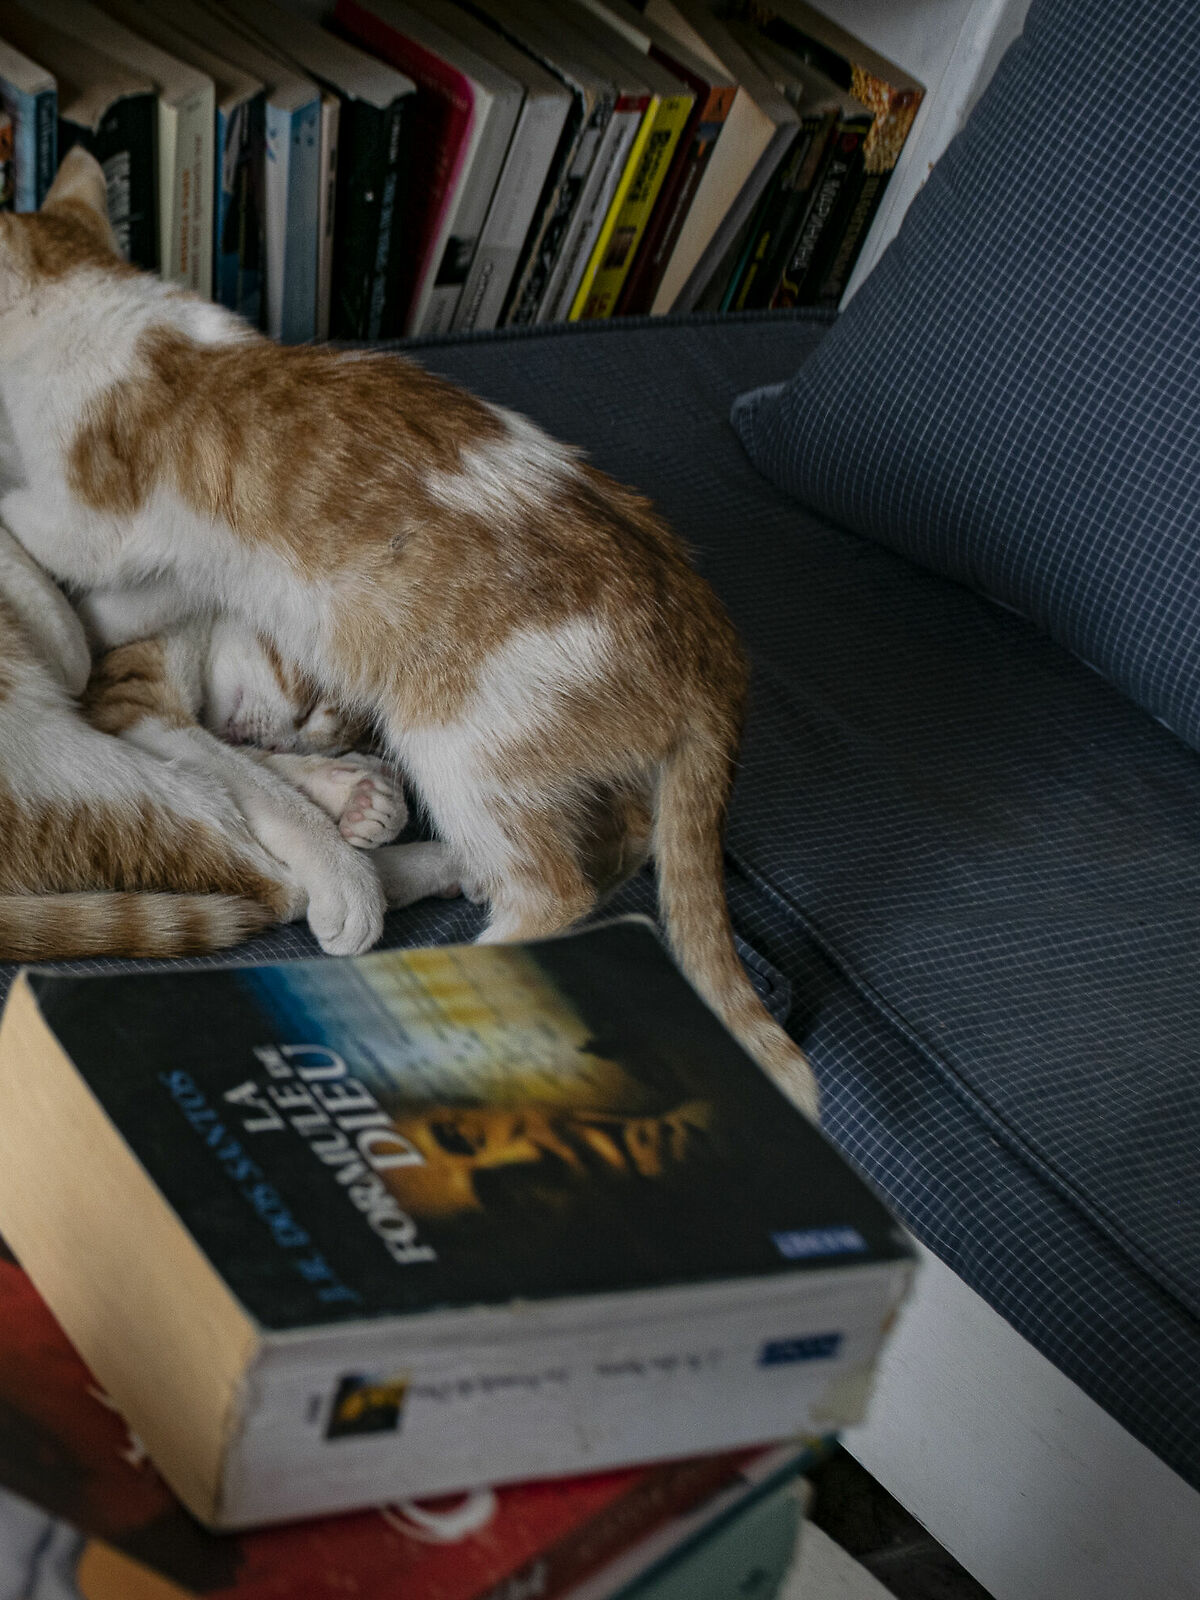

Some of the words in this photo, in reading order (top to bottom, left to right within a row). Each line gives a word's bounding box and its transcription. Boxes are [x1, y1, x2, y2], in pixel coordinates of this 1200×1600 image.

[222, 1079, 286, 1133] LA
[278, 1043, 426, 1170] DIEU
[265, 1081, 438, 1265] FORMULE
